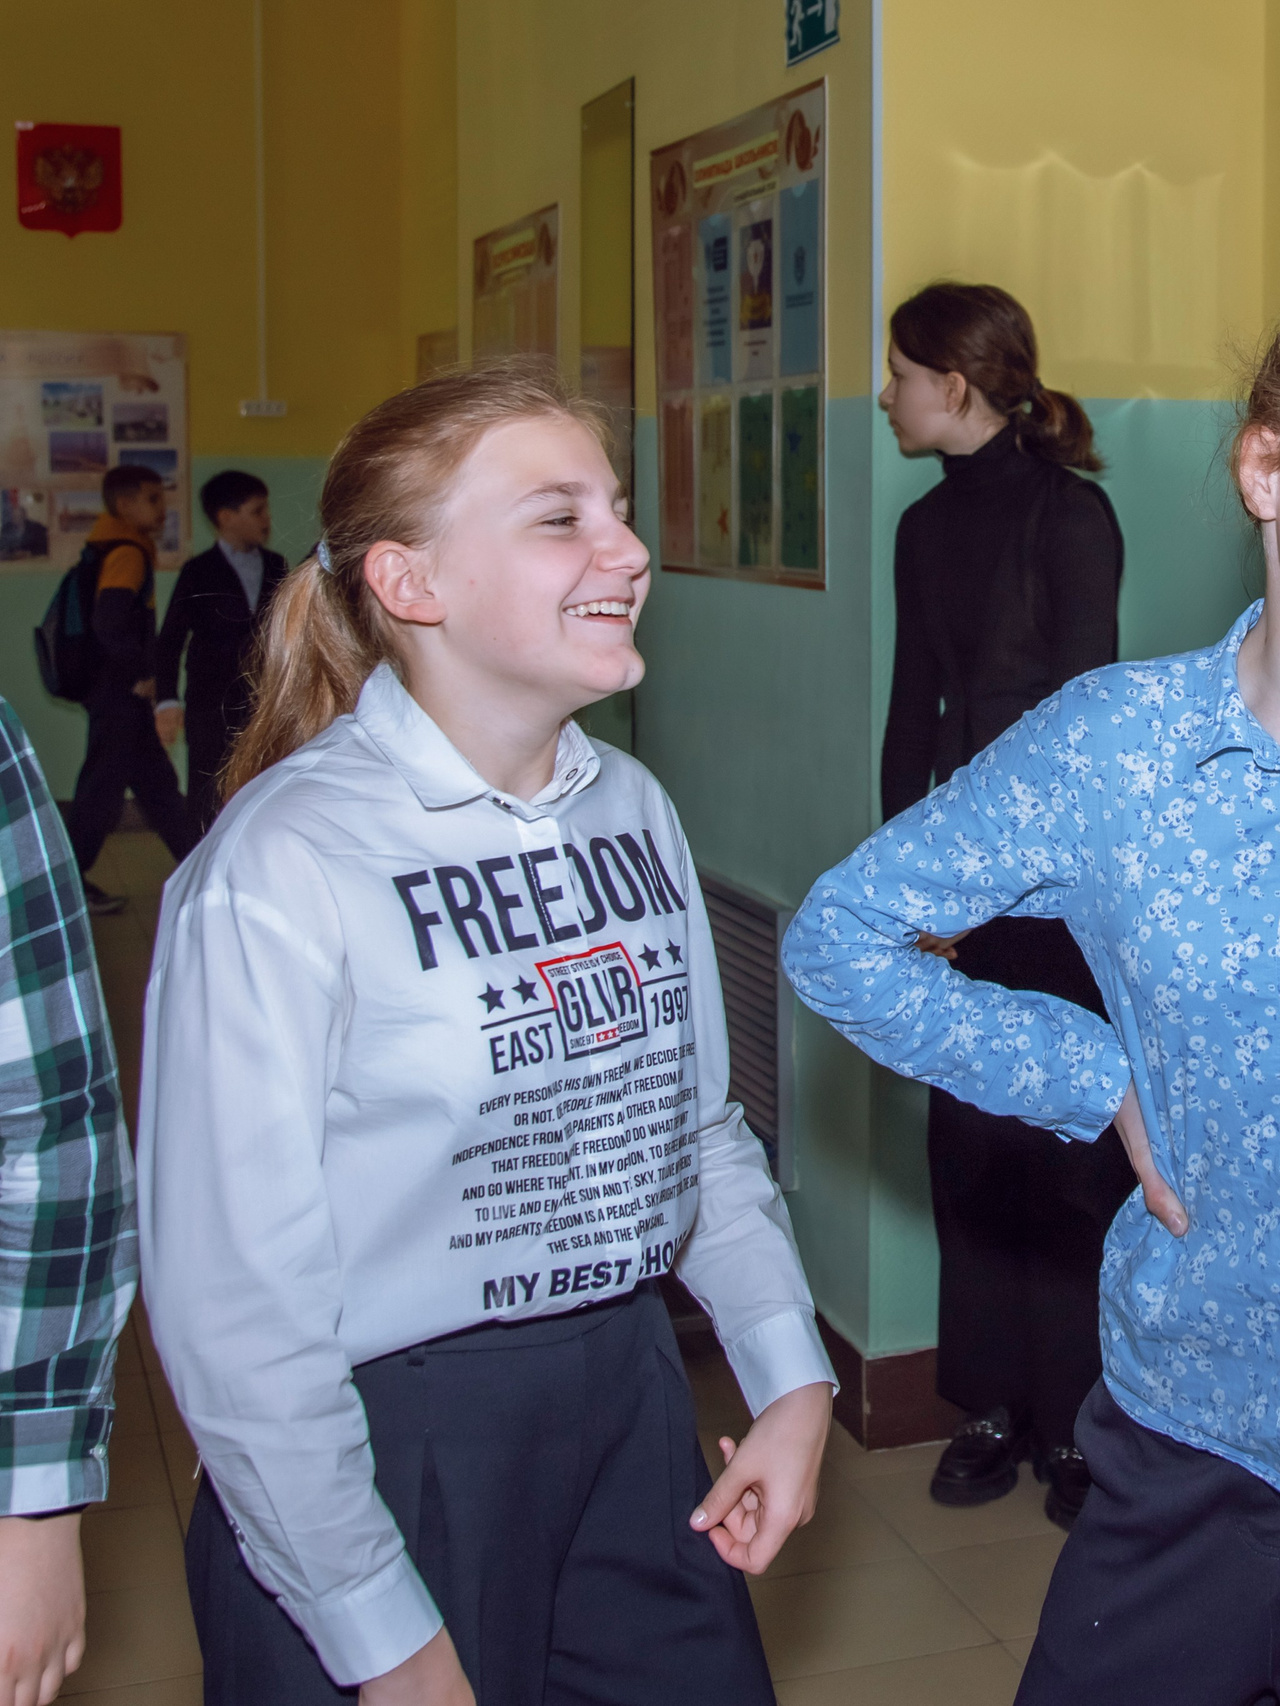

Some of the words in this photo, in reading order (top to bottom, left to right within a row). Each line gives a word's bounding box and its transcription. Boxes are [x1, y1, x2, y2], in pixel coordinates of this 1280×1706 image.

[392, 829, 686, 971] FREEDOM
[548, 965, 571, 977] STREET
[570, 960, 590, 973] STYLE
[557, 965, 637, 1032] GLVR
[650, 985, 688, 1028] 1997
[489, 1022, 552, 1074] EAST
[570, 1035, 585, 1049] SINCE
[586, 1033, 594, 1045] 97
[479, 1093, 511, 1116] EVERY
[513, 1085, 554, 1105] PERSON
[564, 1078, 581, 1091] HIS
[582, 1072, 601, 1089] OWN
[634, 1055, 644, 1071] WE
[646, 1048, 678, 1067] DECIDE
[514, 1112, 529, 1126] OR
[531, 1109, 555, 1125] NOT.
[563, 1096, 593, 1114] PEOPLE
[596, 1088, 622, 1106] THINK
[634, 1070, 678, 1094] FREEDOM
[452, 1134, 531, 1166] INDEPENDENCE
[533, 1129, 563, 1146] FROM
[572, 1113, 614, 1133] PARENTS
[626, 1100, 656, 1119] OTHER
[491, 1157, 519, 1174] THAT
[633, 1126, 646, 1140] DO
[462, 1185, 485, 1201] AND
[488, 1182, 502, 1196] GO
[505, 1177, 544, 1194] WHERE
[586, 1163, 596, 1178] IN
[599, 1160, 615, 1176] MY
[649, 1145, 662, 1160] TO
[475, 1207, 489, 1222] TO
[492, 1204, 516, 1221] LIVE
[519, 1201, 541, 1217] AND
[579, 1186, 601, 1203] SUN
[603, 1182, 622, 1198] AND
[634, 1170, 657, 1187] SKY,
[449, 1233, 472, 1250] AND
[475, 1230, 493, 1247] MY
[495, 1222, 542, 1243] PARENTS
[585, 1210, 596, 1224] IS
[598, 1208, 605, 1222] A
[645, 1194, 660, 1209] SKY
[547, 1237, 570, 1255] THE
[571, 1232, 593, 1249] SEA
[594, 1230, 614, 1245] AND
[614, 1227, 633, 1243] THE
[483, 1272, 540, 1310] MY
[548, 1258, 632, 1298] BEST
